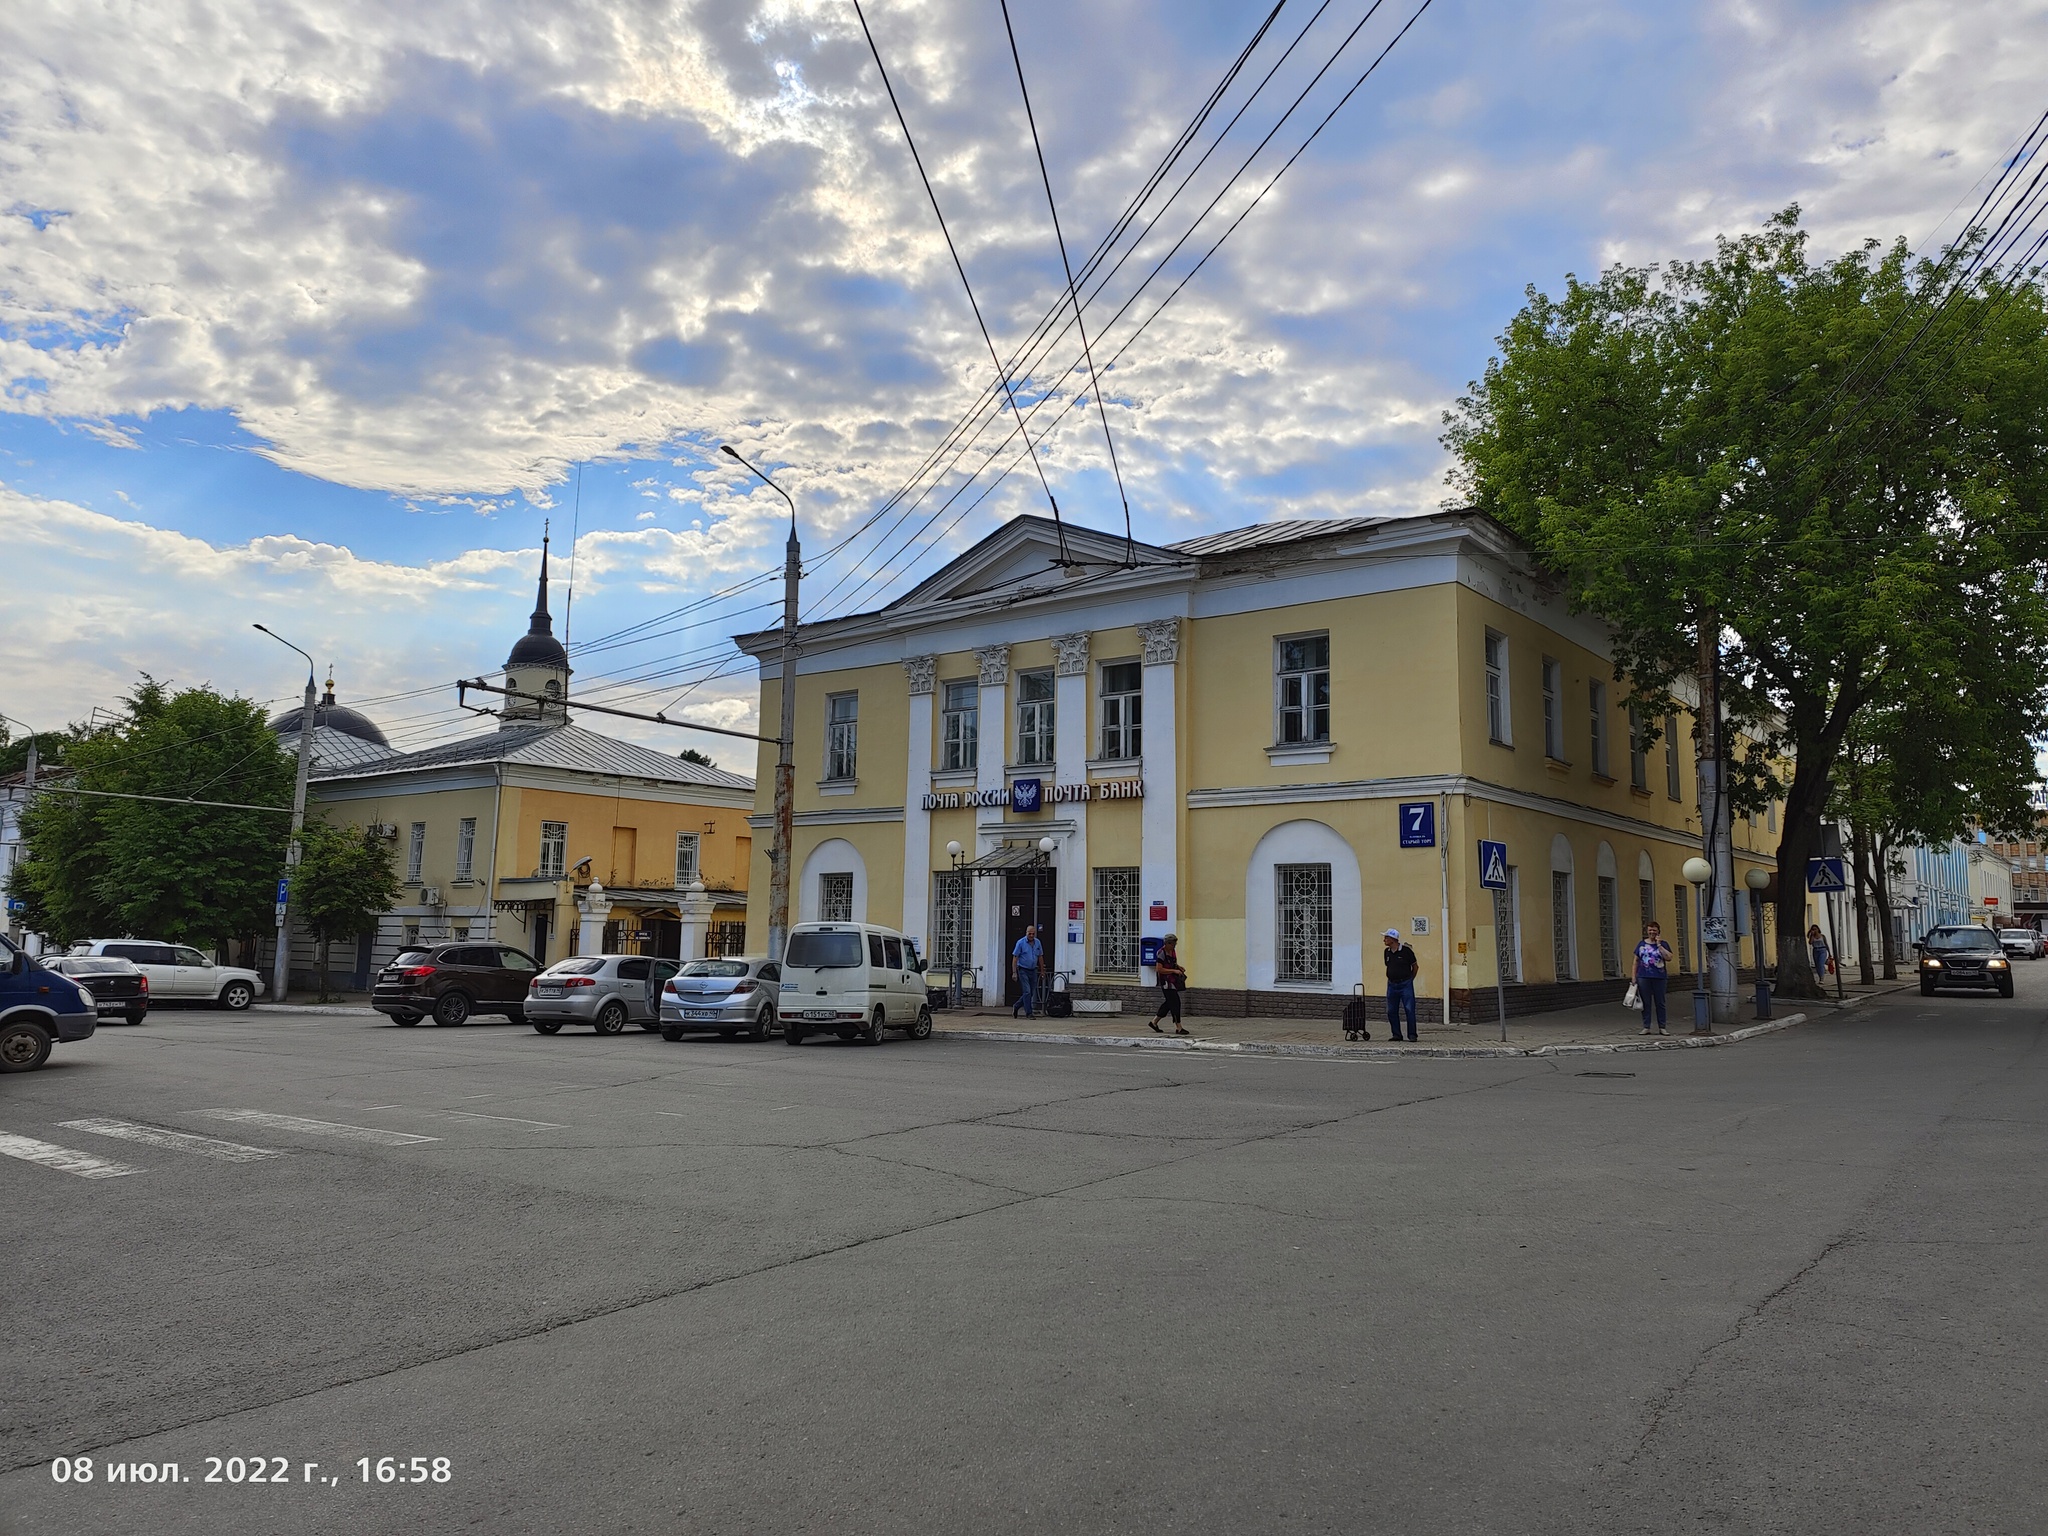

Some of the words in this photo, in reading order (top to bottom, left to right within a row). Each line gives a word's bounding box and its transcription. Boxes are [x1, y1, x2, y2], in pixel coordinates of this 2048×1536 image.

[922, 793, 960, 810] ПОЧТА
[965, 788, 1011, 807] РОССИИ
[1044, 784, 1092, 804] ПОЧТА
[1100, 780, 1145, 801] БАНК
[1409, 807, 1425, 831] 7
